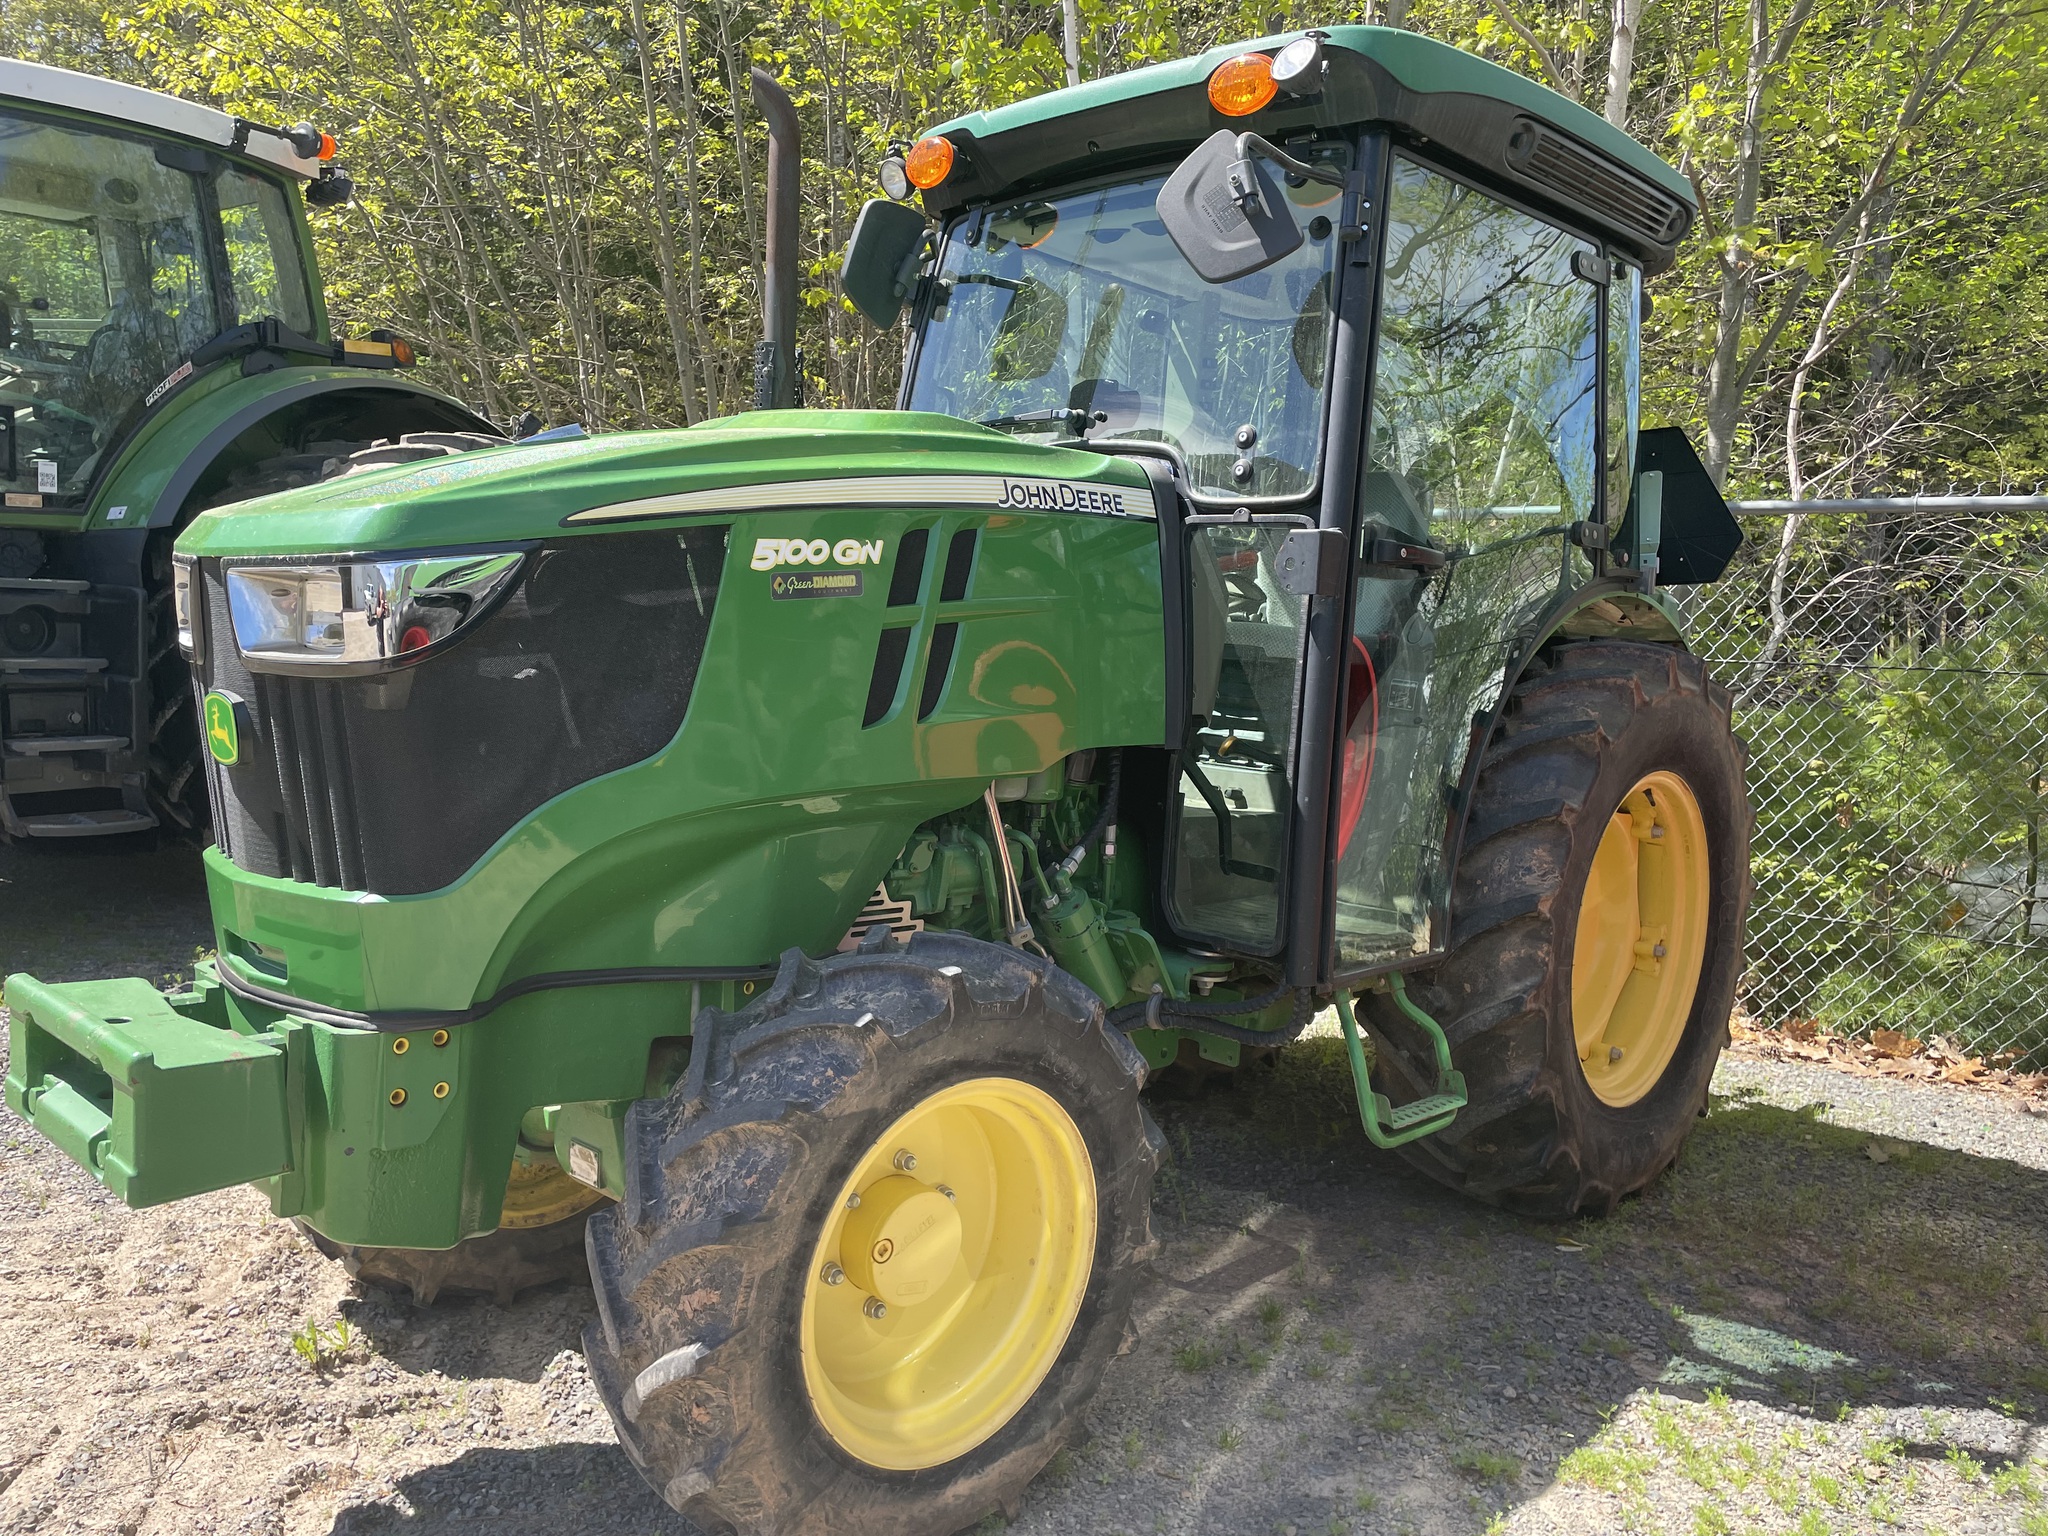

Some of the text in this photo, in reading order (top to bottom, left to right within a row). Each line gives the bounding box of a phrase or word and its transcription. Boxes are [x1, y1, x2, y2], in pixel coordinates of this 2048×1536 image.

[146, 378, 171, 405] PROFI
[998, 479, 1126, 515] JOHN DEERE
[750, 538, 885, 571] 5100 GN
[787, 574, 857, 595] Green DIAMOND
